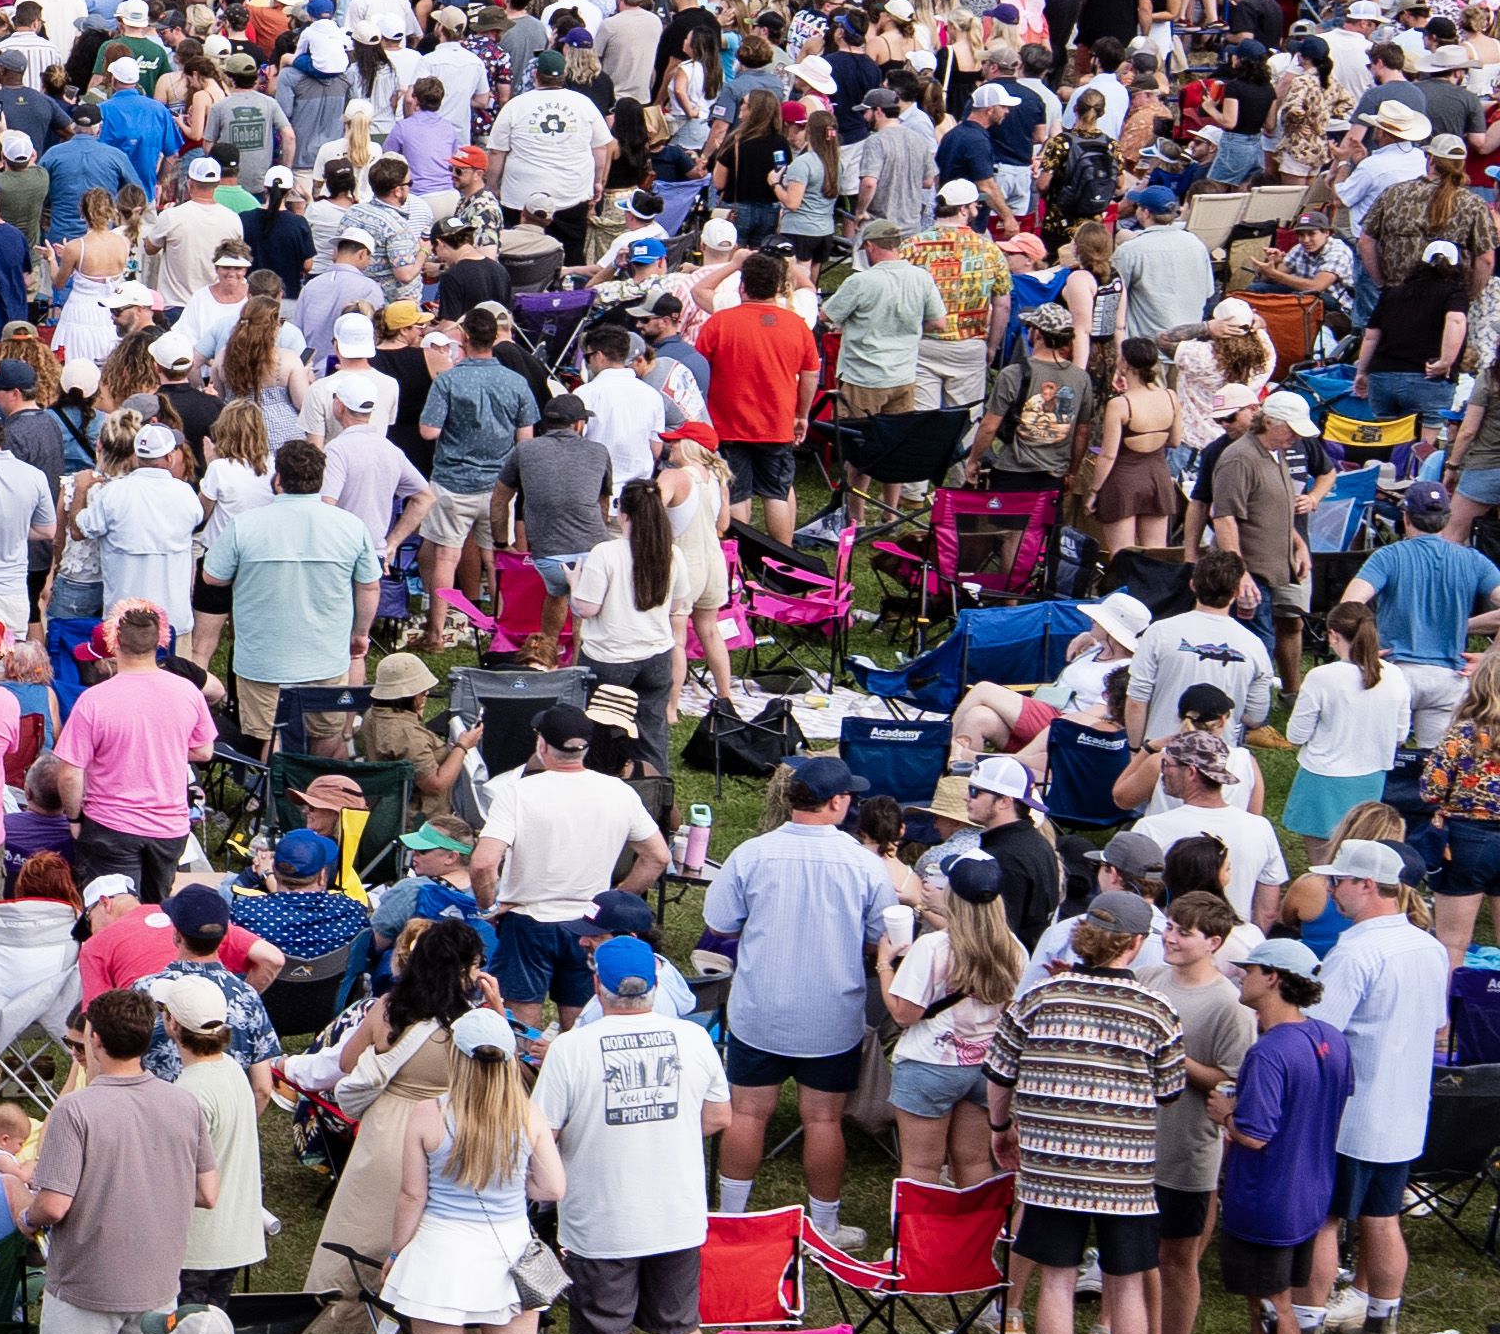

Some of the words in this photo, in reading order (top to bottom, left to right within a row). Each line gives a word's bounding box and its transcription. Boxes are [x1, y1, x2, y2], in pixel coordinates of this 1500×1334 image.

[529, 102, 577, 126] CARHARTT
[871, 727, 924, 740] Academy
[1077, 733, 1127, 750] Academy
[602, 1034, 638, 1050] NORTH
[639, 1031, 675, 1047] SHORE
[621, 1105, 665, 1123] PIPELINE
